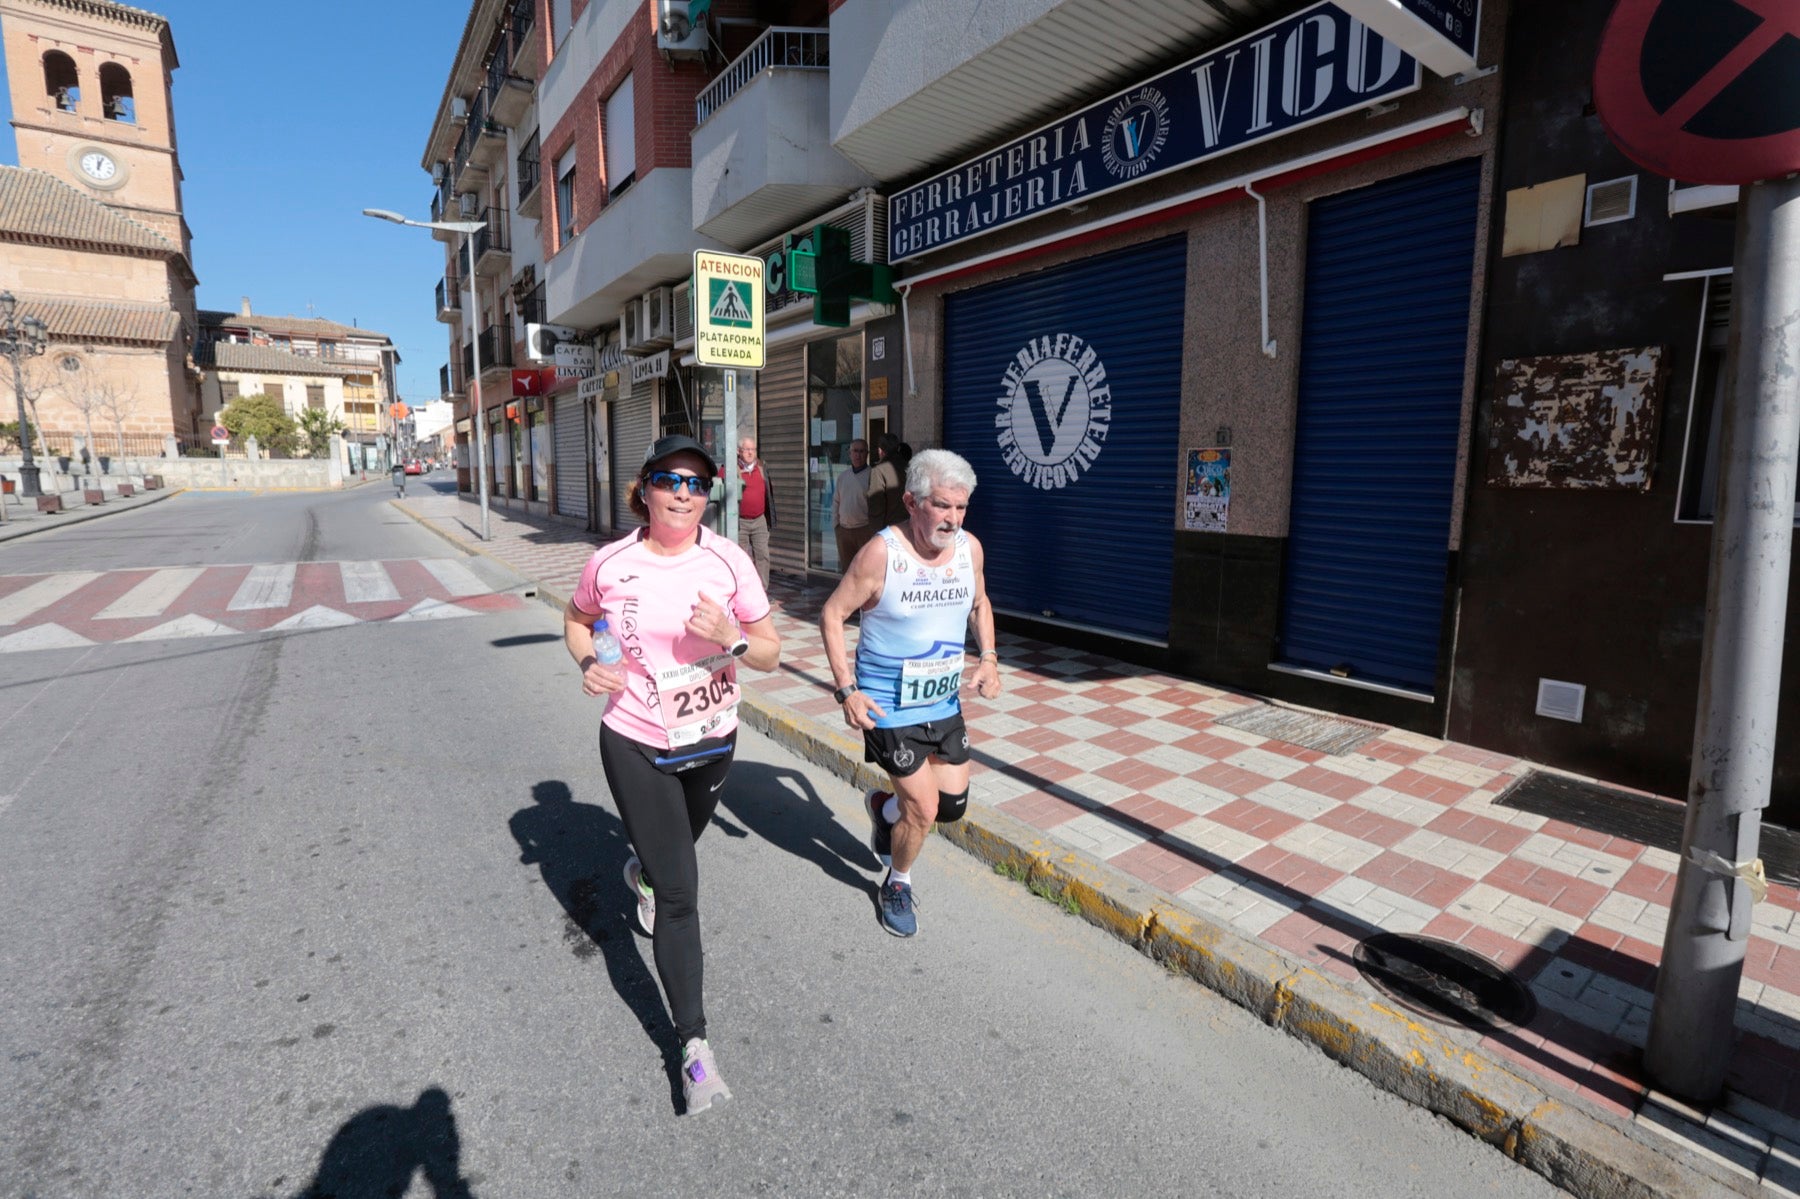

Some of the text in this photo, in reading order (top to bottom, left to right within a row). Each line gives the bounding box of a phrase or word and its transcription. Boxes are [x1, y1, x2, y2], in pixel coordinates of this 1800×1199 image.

[895, 117, 1091, 225] FERRETERIA
[895, 160, 1088, 255] CERRAJERIA
[700, 259, 761, 278] ATENCION
[700, 331, 761, 346] PLATAFORMA
[573, 357, 592, 366] BAR
[710, 347, 752, 359] ELEVADA
[634, 362, 653, 380] LIMA
[1022, 375, 1079, 457] V
[900, 586, 969, 603] MARACENA
[680, 664, 695, 675] GRAN
[673, 671, 735, 718] 2304
[907, 672, 960, 701] 1080
